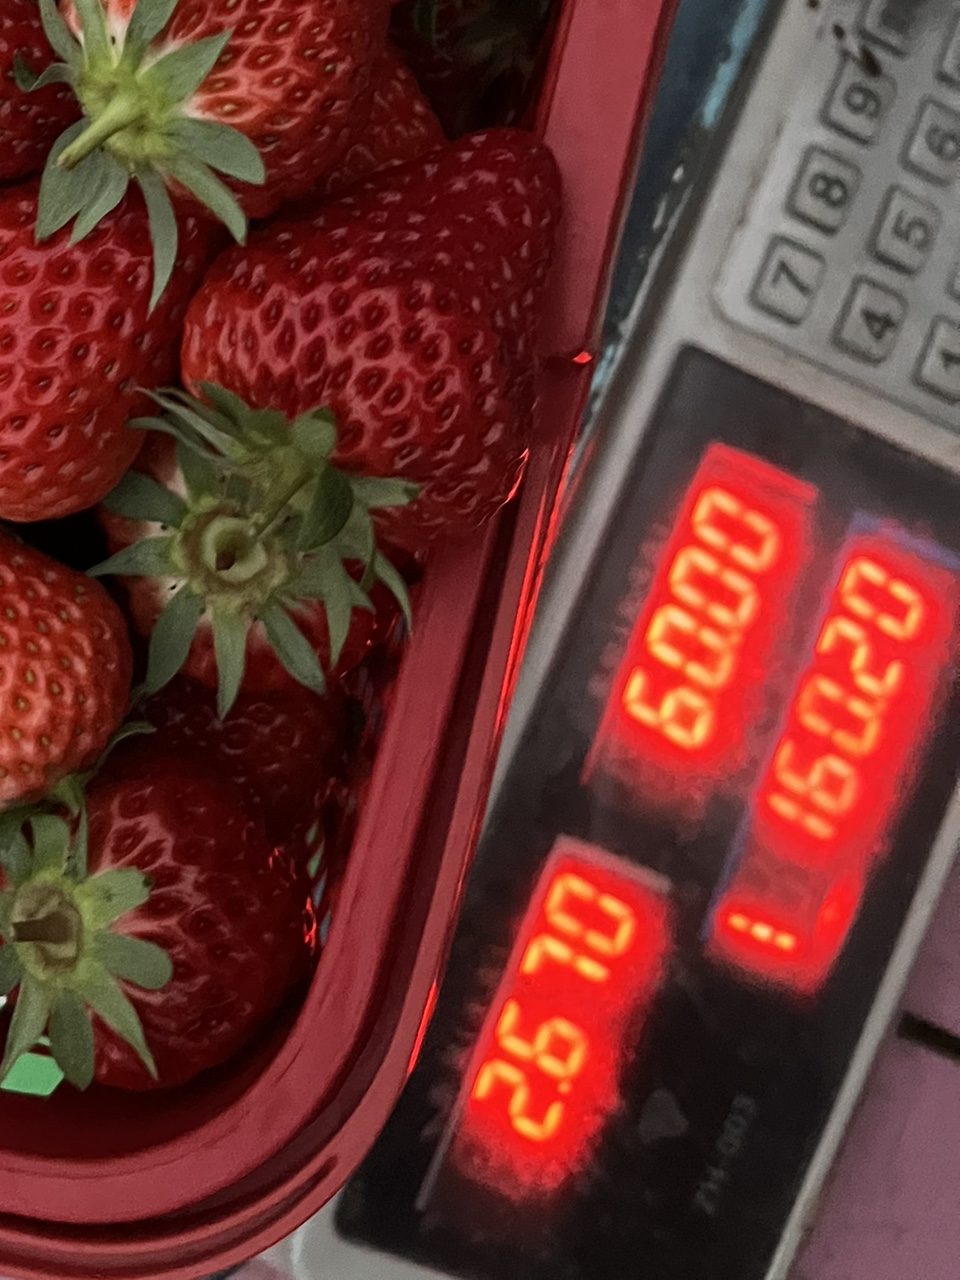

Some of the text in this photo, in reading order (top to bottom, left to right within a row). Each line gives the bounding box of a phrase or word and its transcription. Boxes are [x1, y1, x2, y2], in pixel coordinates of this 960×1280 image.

[843, 80, 883, 117] 9
[808, 172, 848, 209] 8
[892, 208, 931, 250] 5
[771, 259, 813, 298] 7
[861, 307, 895, 340] 4
[473, 873, 635, 1142] 2.670
